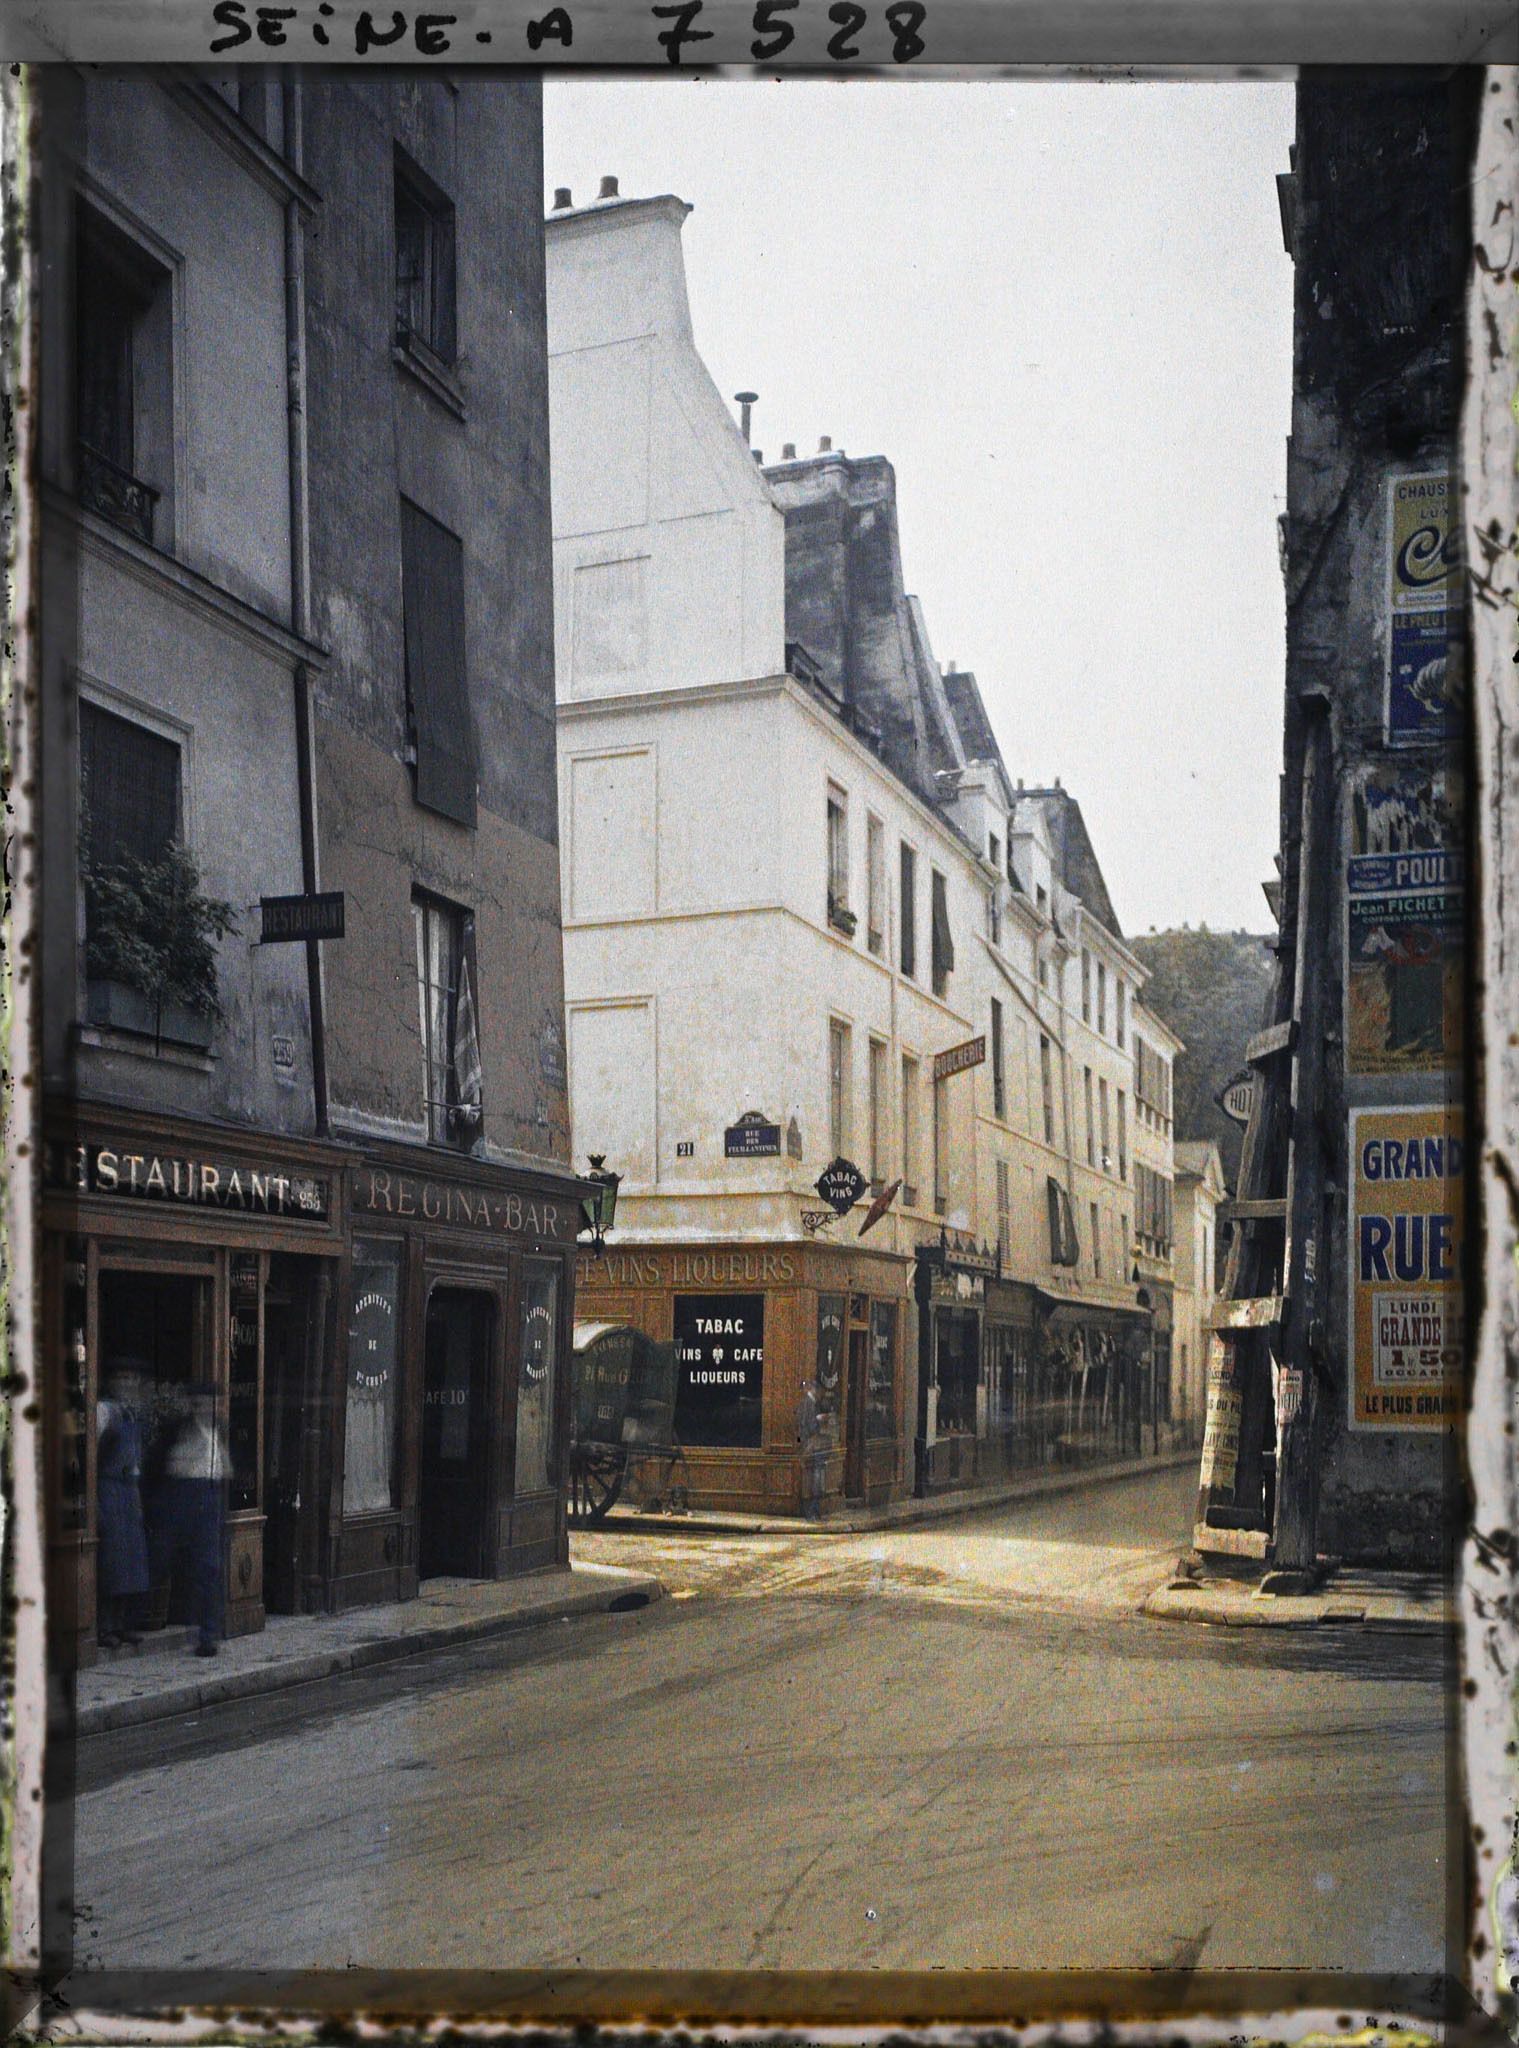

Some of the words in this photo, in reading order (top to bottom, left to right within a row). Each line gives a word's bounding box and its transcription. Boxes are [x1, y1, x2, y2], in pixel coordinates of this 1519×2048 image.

[527, 8, 573, 50] A
[1352, 902, 1386, 916] Jean
[1387, 896, 1447, 913] FICHET
[263, 902, 341, 934] RESTAURANT
[935, 1039, 984, 1078] BOUCHERIE
[679, 1143, 692, 1155] 21
[728, 1144, 777, 1153] FEUILLANTINES
[822, 1171, 858, 1186] TABAC
[604, 1256, 661, 1284] VINS
[672, 1252, 796, 1285] LIQUEURS
[1390, 1301, 1437, 1314] LUNDI
[695, 1318, 745, 1335] TABAC
[1380, 1316, 1442, 1347] GRANDE
[675, 1348, 702, 1361] VINS
[734, 1348, 764, 1361] CAFE
[690, 1371, 747, 1384] LIQUEURS
[1365, 1395, 1379, 1414] LE
[1381, 1394, 1413, 1414] PLUS
